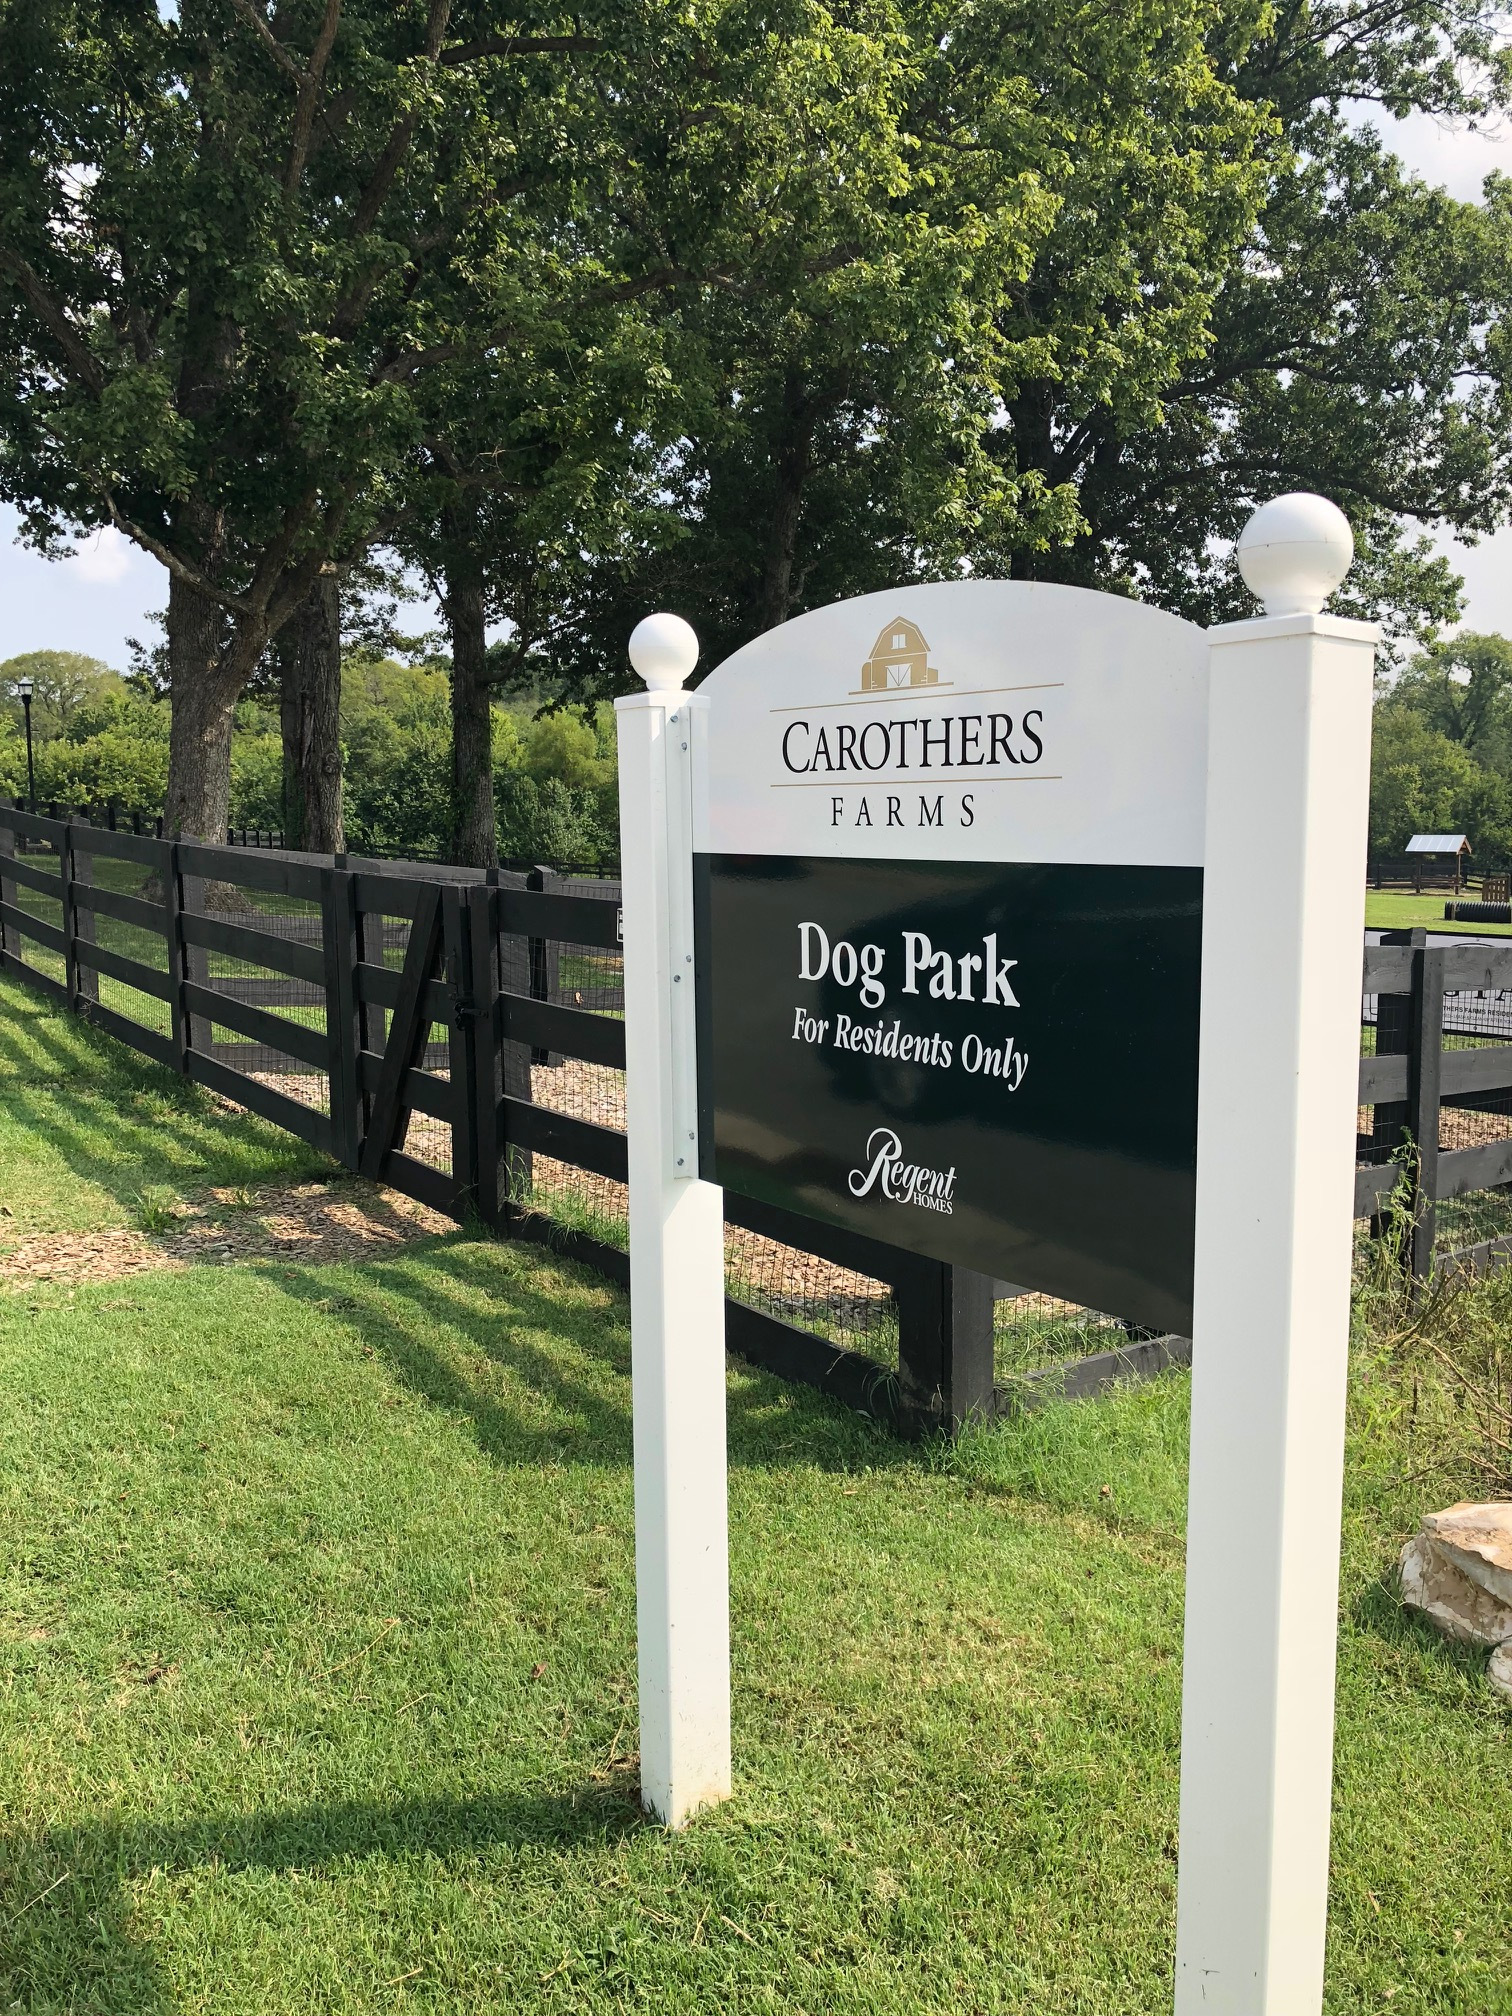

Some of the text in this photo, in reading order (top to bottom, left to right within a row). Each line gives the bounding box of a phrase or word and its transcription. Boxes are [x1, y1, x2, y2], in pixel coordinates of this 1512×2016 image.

[782, 710, 1043, 773] CAROTHERS
[830, 794, 975, 827] FARMS
[797, 921, 1021, 1009] Dog Park
[791, 1006, 1029, 1092] For Residents Only
[848, 1127, 958, 1204] Regent
[913, 1191, 953, 1215] HOMES
